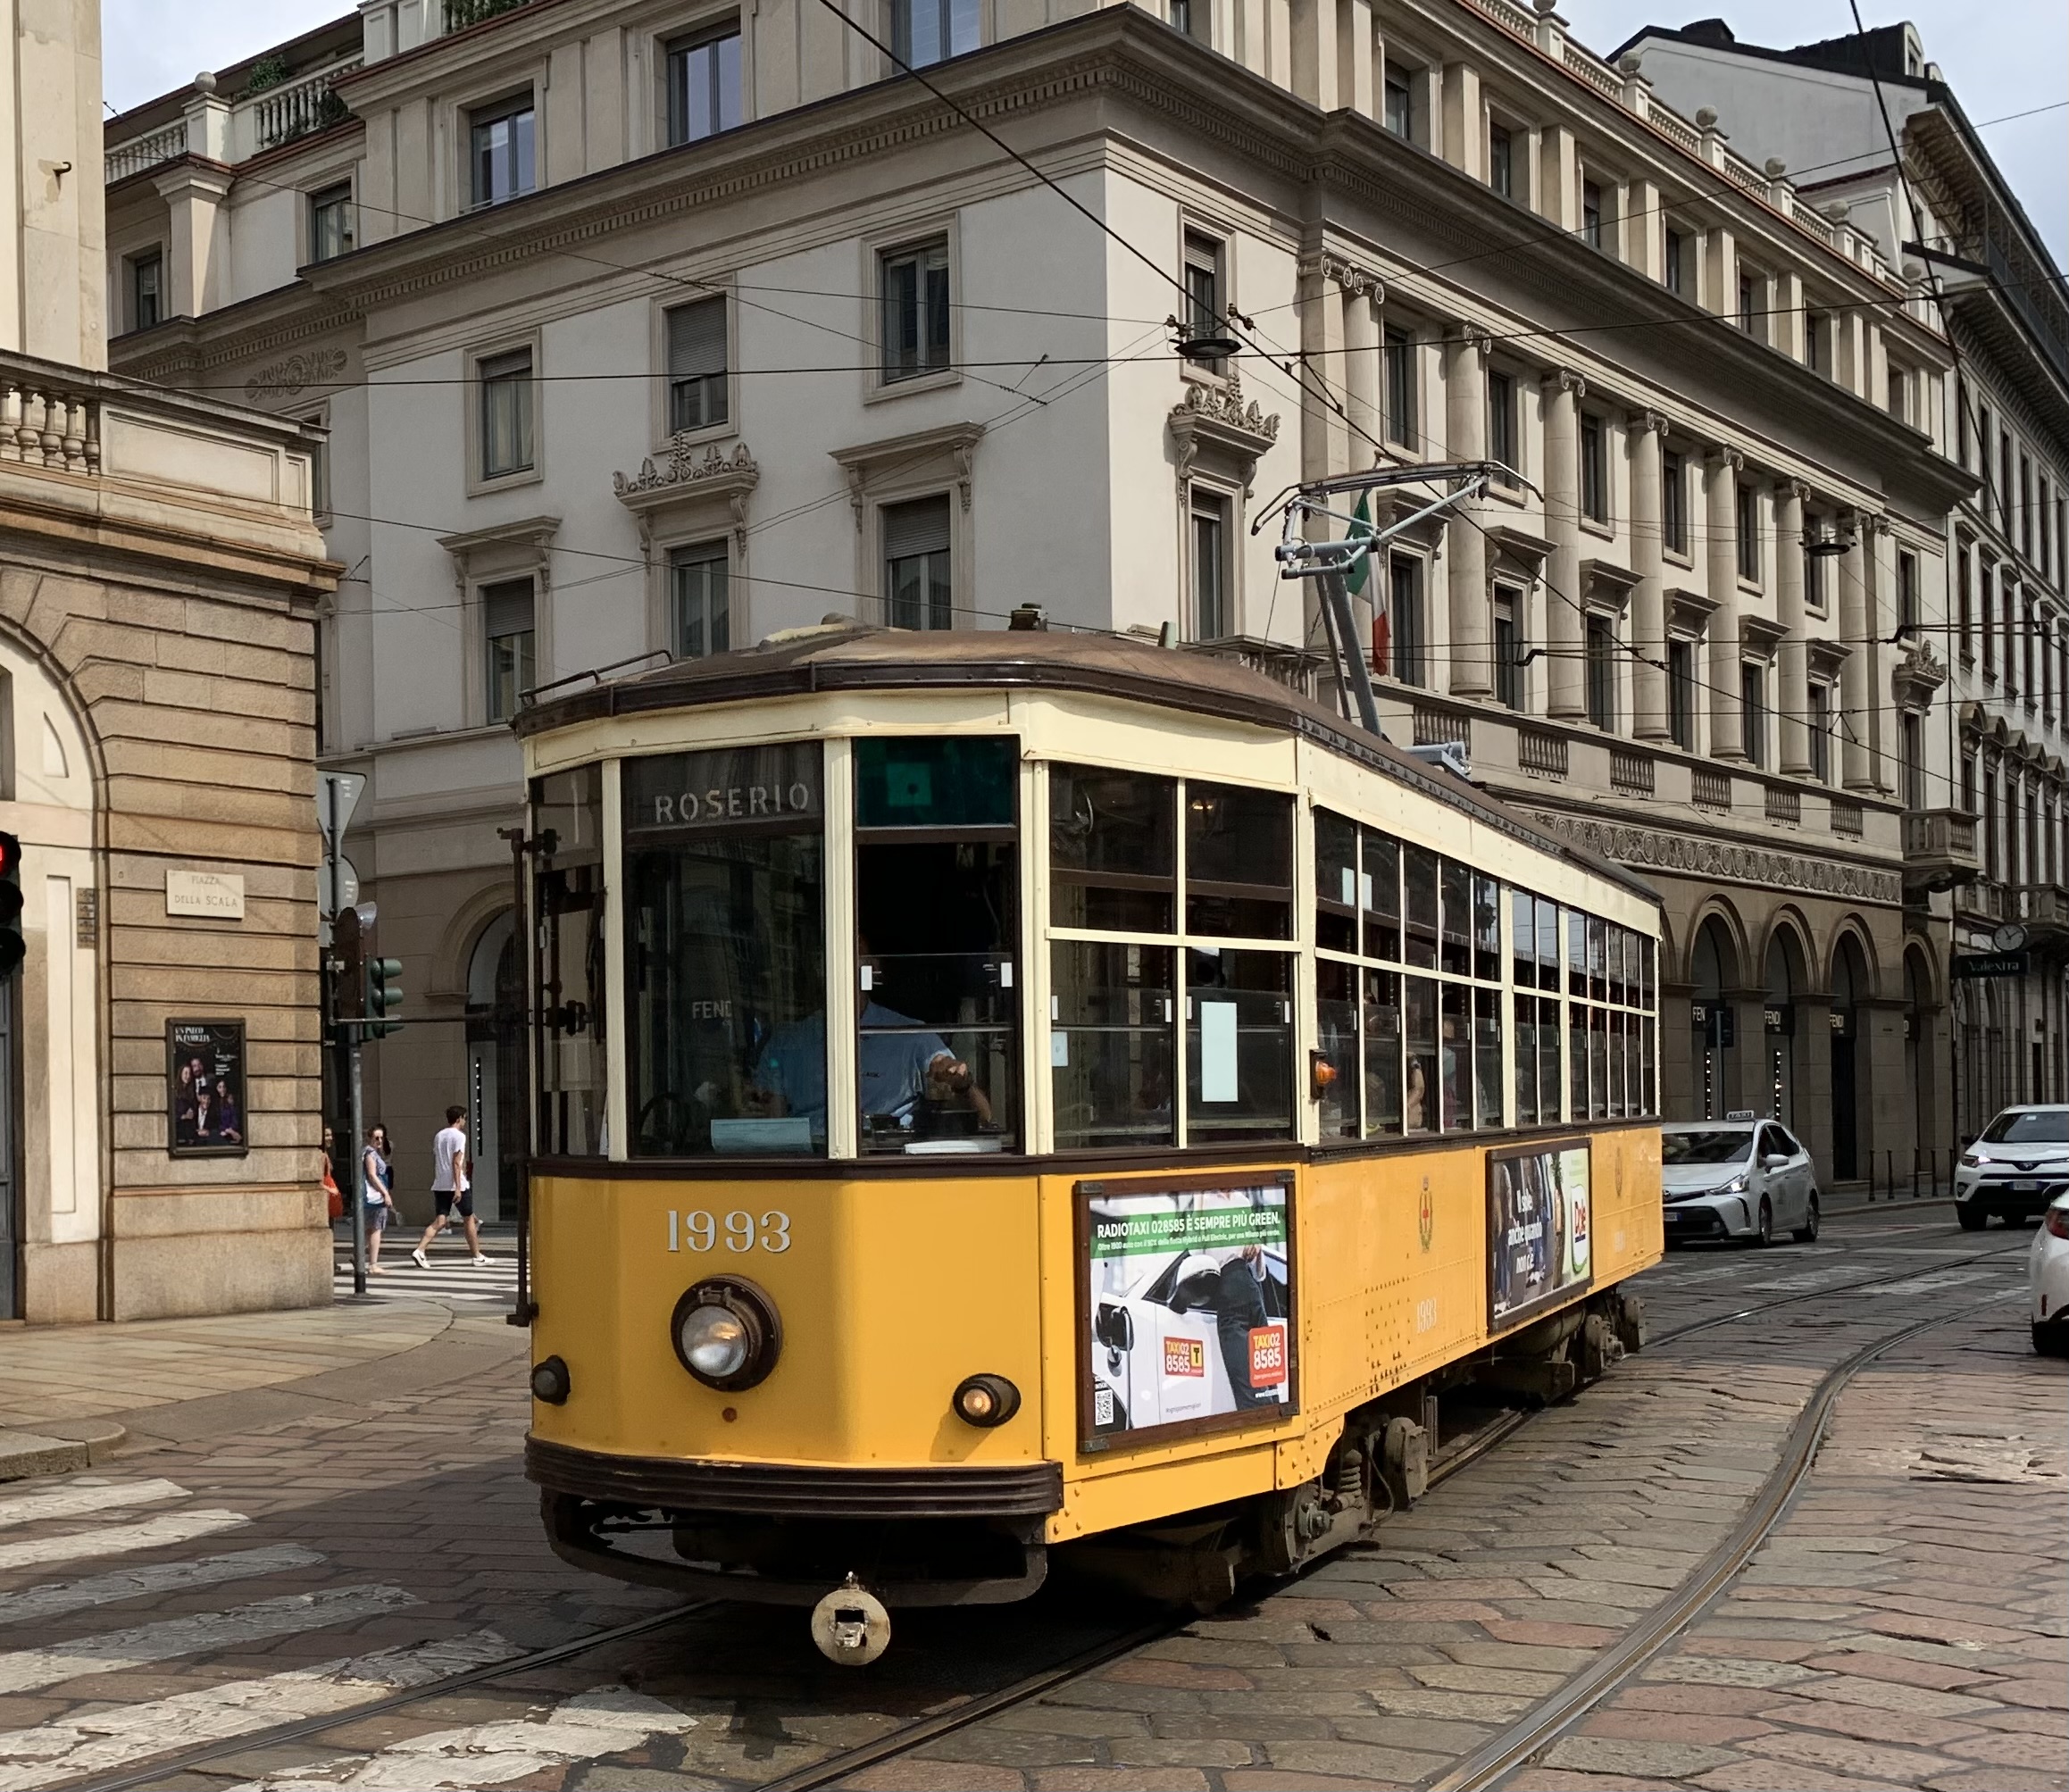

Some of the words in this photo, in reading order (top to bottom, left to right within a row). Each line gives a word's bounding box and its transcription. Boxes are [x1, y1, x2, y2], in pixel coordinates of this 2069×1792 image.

[655, 782, 809, 823] ROSERIO
[191, 875, 221, 886] PIAZZA
[174, 895, 202, 905] DELLA
[206, 896, 238, 908] SCALA
[1969, 959, 2020, 972] Valextra
[1764, 1010, 1781, 1025] FENDI
[1830, 1014, 1845, 1027] FENDI
[667, 1210, 791, 1254] 1993
[1097, 1221, 1150, 1238] RADIOTAXI
[1151, 1218, 1185, 1234] 028585
[1186, 1214, 1193, 1231] È
[1194, 1214, 1231, 1230] SEMPRE
[1232, 1210, 1247, 1228] PIÙ
[1248, 1211, 1281, 1227] GREEN.
[1166, 1354, 1191, 1372] 8585
[1254, 1347, 1282, 1370] 8585
